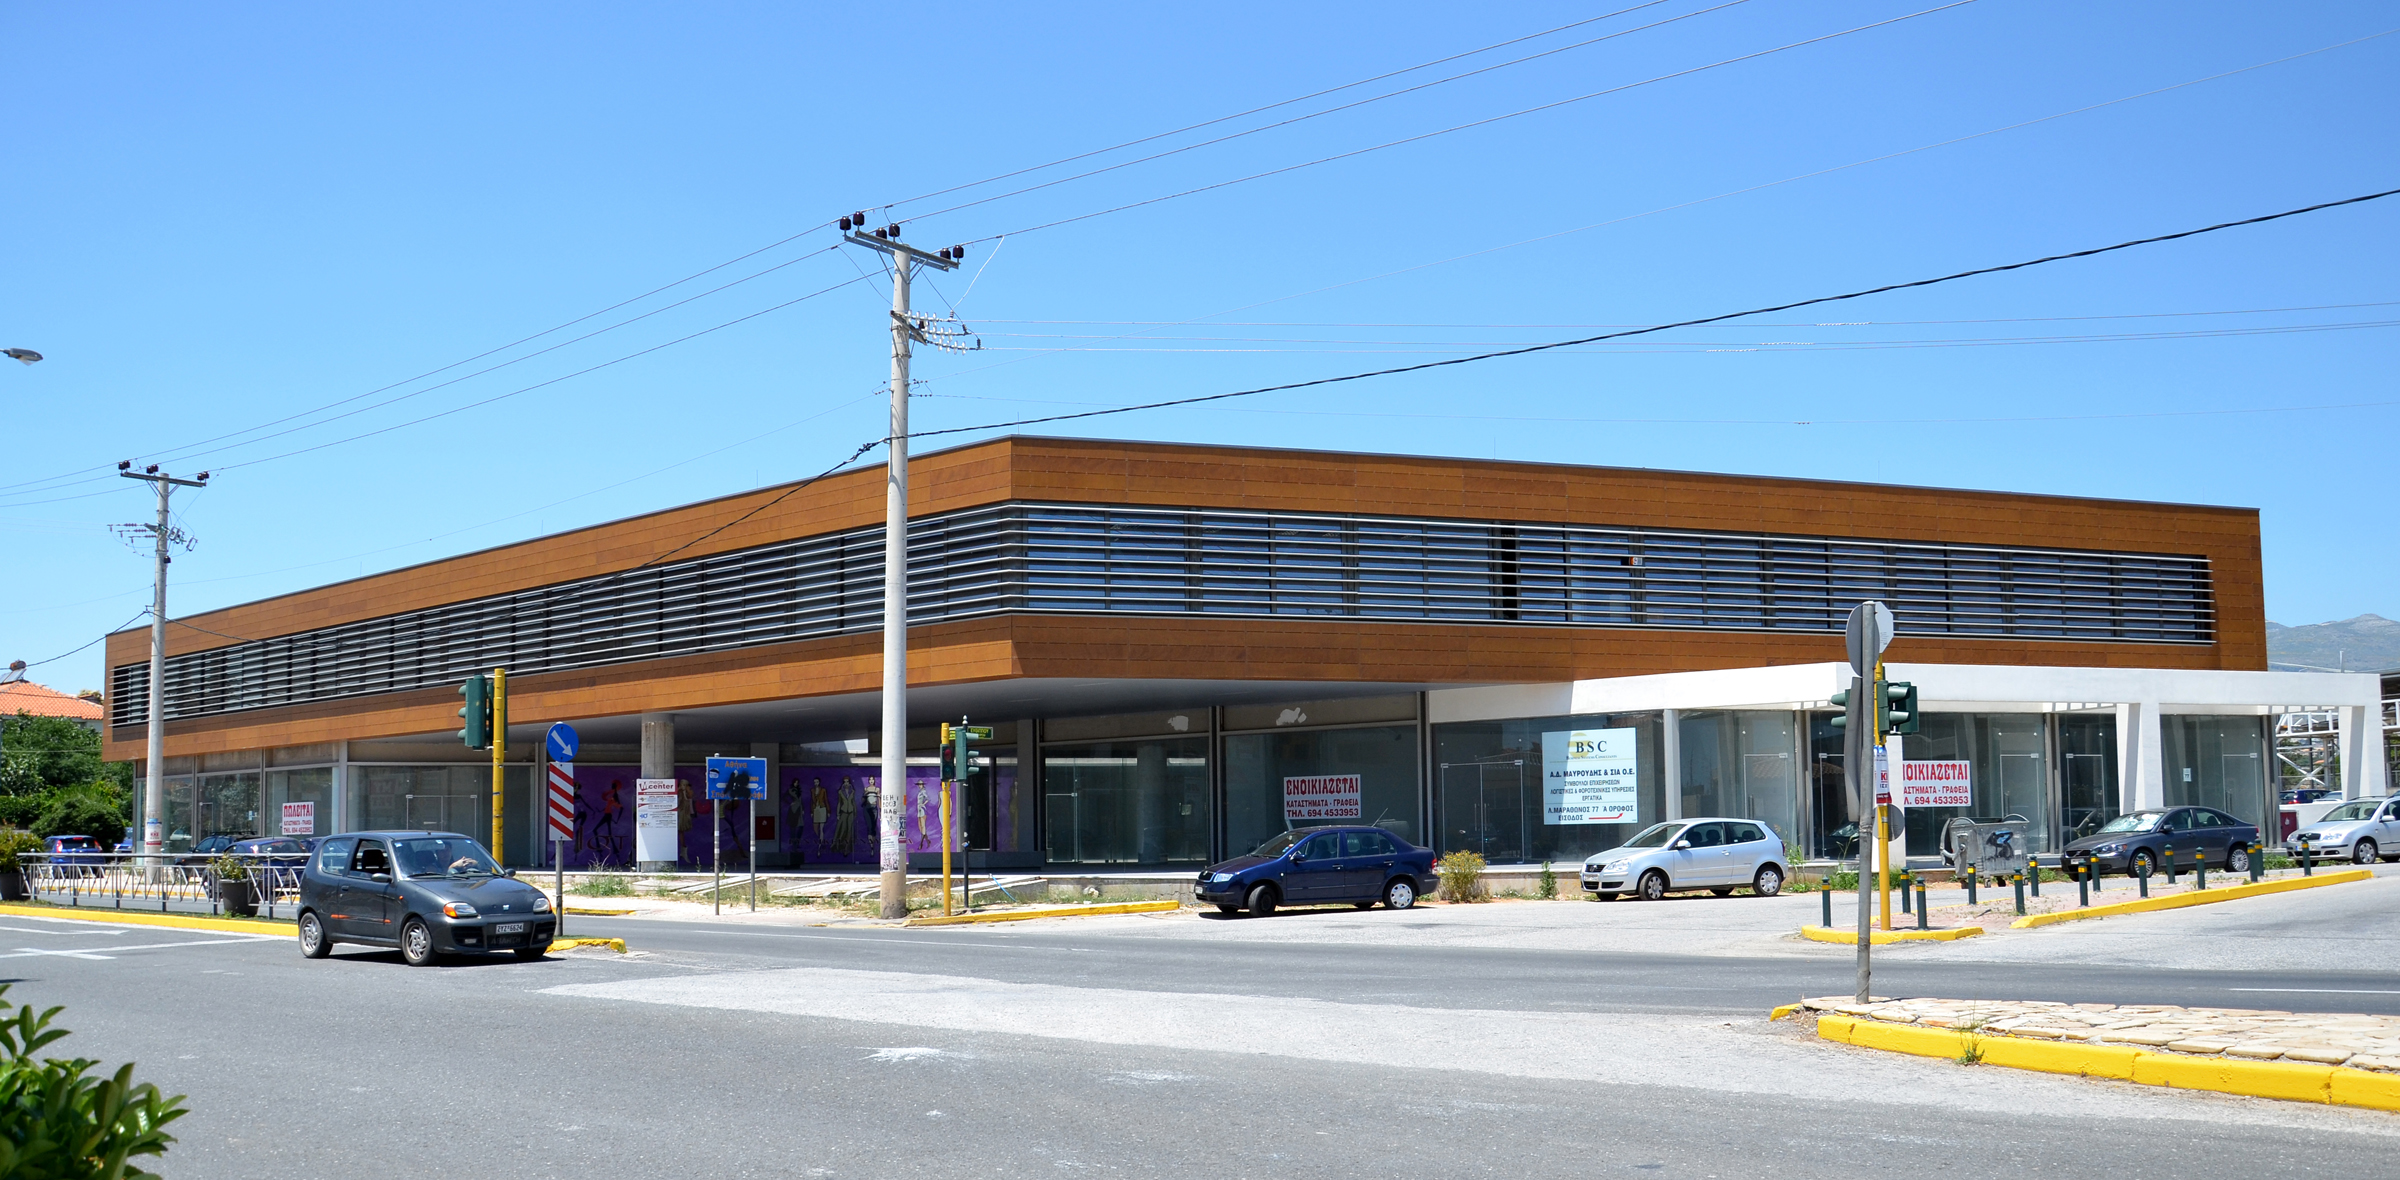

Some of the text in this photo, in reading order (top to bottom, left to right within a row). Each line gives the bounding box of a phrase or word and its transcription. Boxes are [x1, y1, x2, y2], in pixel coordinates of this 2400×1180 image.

[725, 760, 747, 769] Αθήνα
[1563, 769, 1602, 777] ΜΑΥΡΟΥΔΗΣ
[1903, 763, 1967, 781] ΟΙΚΙΑΖΕΤΑΙ
[1286, 777, 1358, 795] ΕΝΟΙΚΙΑΖΕΤΑΙ
[1904, 786, 1936, 794] ΑΣΤΗΜΑΤΑ
[1942, 785, 1968, 793] ΓΡΑΦΕΙΑ
[1286, 799, 1328, 807] ΚΑΤΑΣΤΗΜΑΤΑ
[1333, 798, 1358, 806] ΓΡΑΦΕΙΑ
[1915, 796, 1930, 804] 694
[1933, 796, 1968, 804] 4533953
[1287, 808, 1359, 817] ΤΗΛ. 694 4533953
